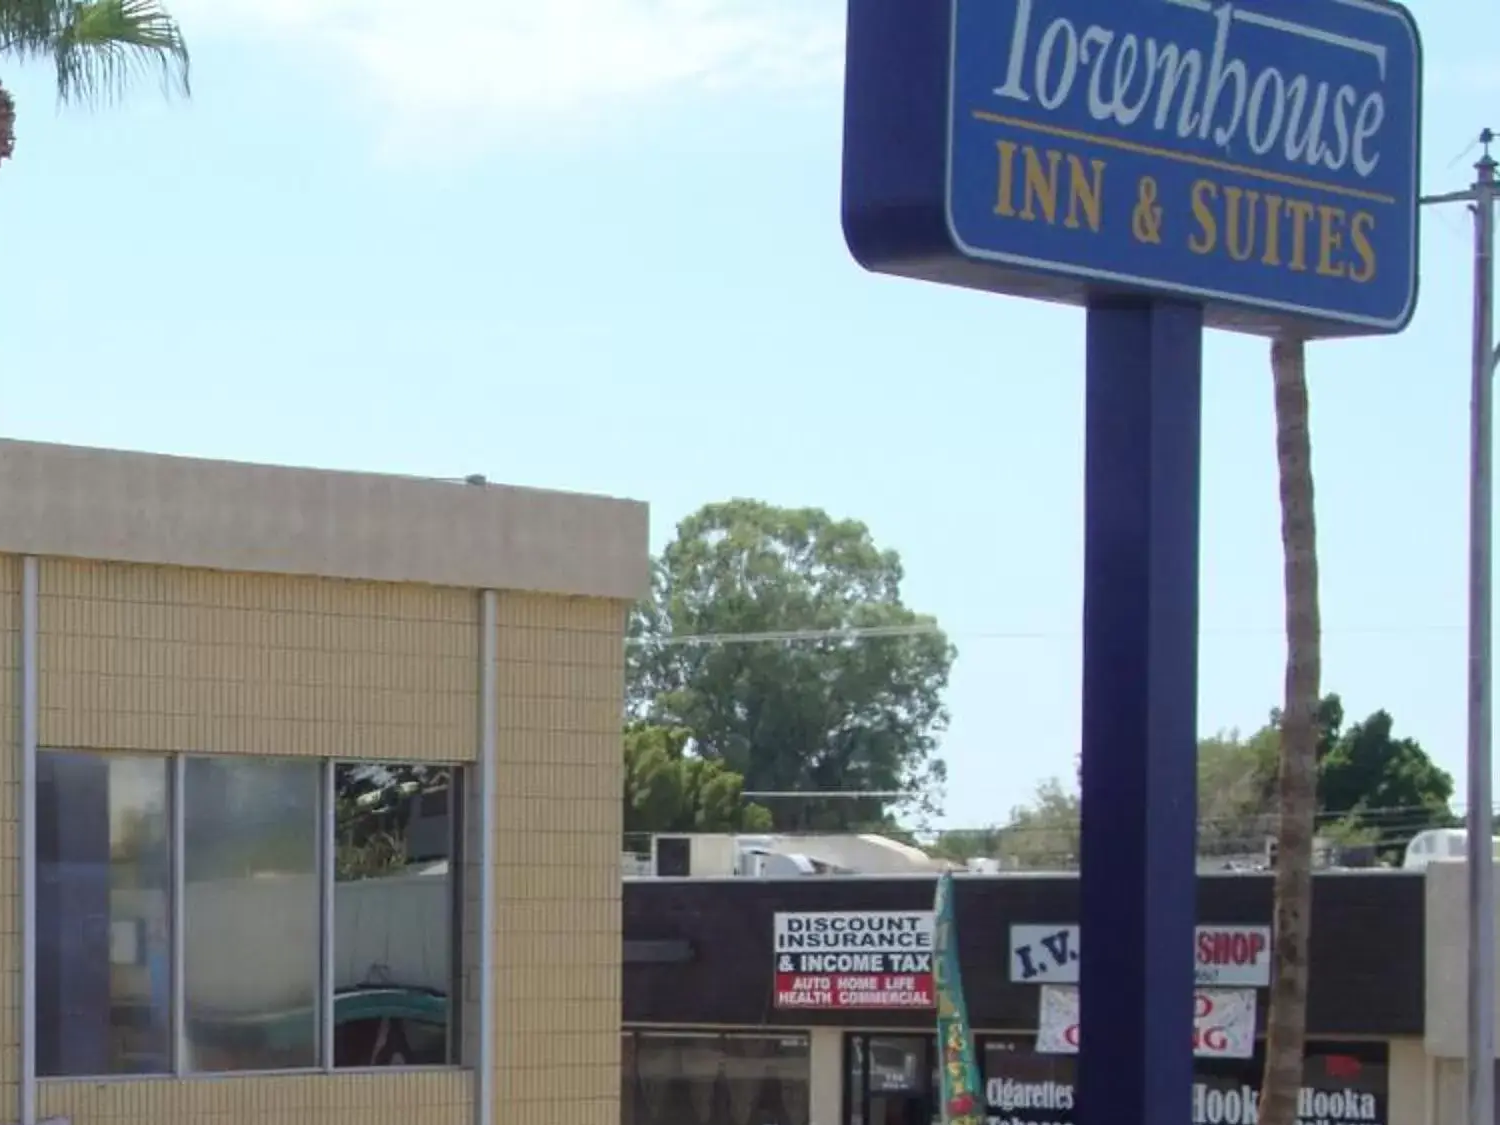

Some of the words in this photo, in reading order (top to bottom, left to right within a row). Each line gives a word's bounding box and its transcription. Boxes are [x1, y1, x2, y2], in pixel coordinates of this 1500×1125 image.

[993, 0, 1387, 178] Townhouse
[994, 140, 1106, 232] INN
[1131, 176, 1163, 245] &
[1188, 179, 1378, 284] SUITES
[778, 933, 930, 948] INSURANCE
[787, 917, 921, 932] DISCOUNT
[779, 954, 794, 972] &
[801, 954, 883, 972] INCOME
[890, 954, 930, 972] TAX
[1197, 932, 1265, 966] SHOP
[779, 991, 832, 1005] HEALTH
[839, 991, 931, 1005] COMMERCIAL
[792, 976, 831, 990] AUTO
[837, 976, 877, 990] HOME
[885, 976, 916, 990] LIFE
[986, 1077, 1075, 1111] Cigarettes
[1192, 1083, 1258, 1125] Hook
[1297, 1087, 1377, 1119] Hooka
